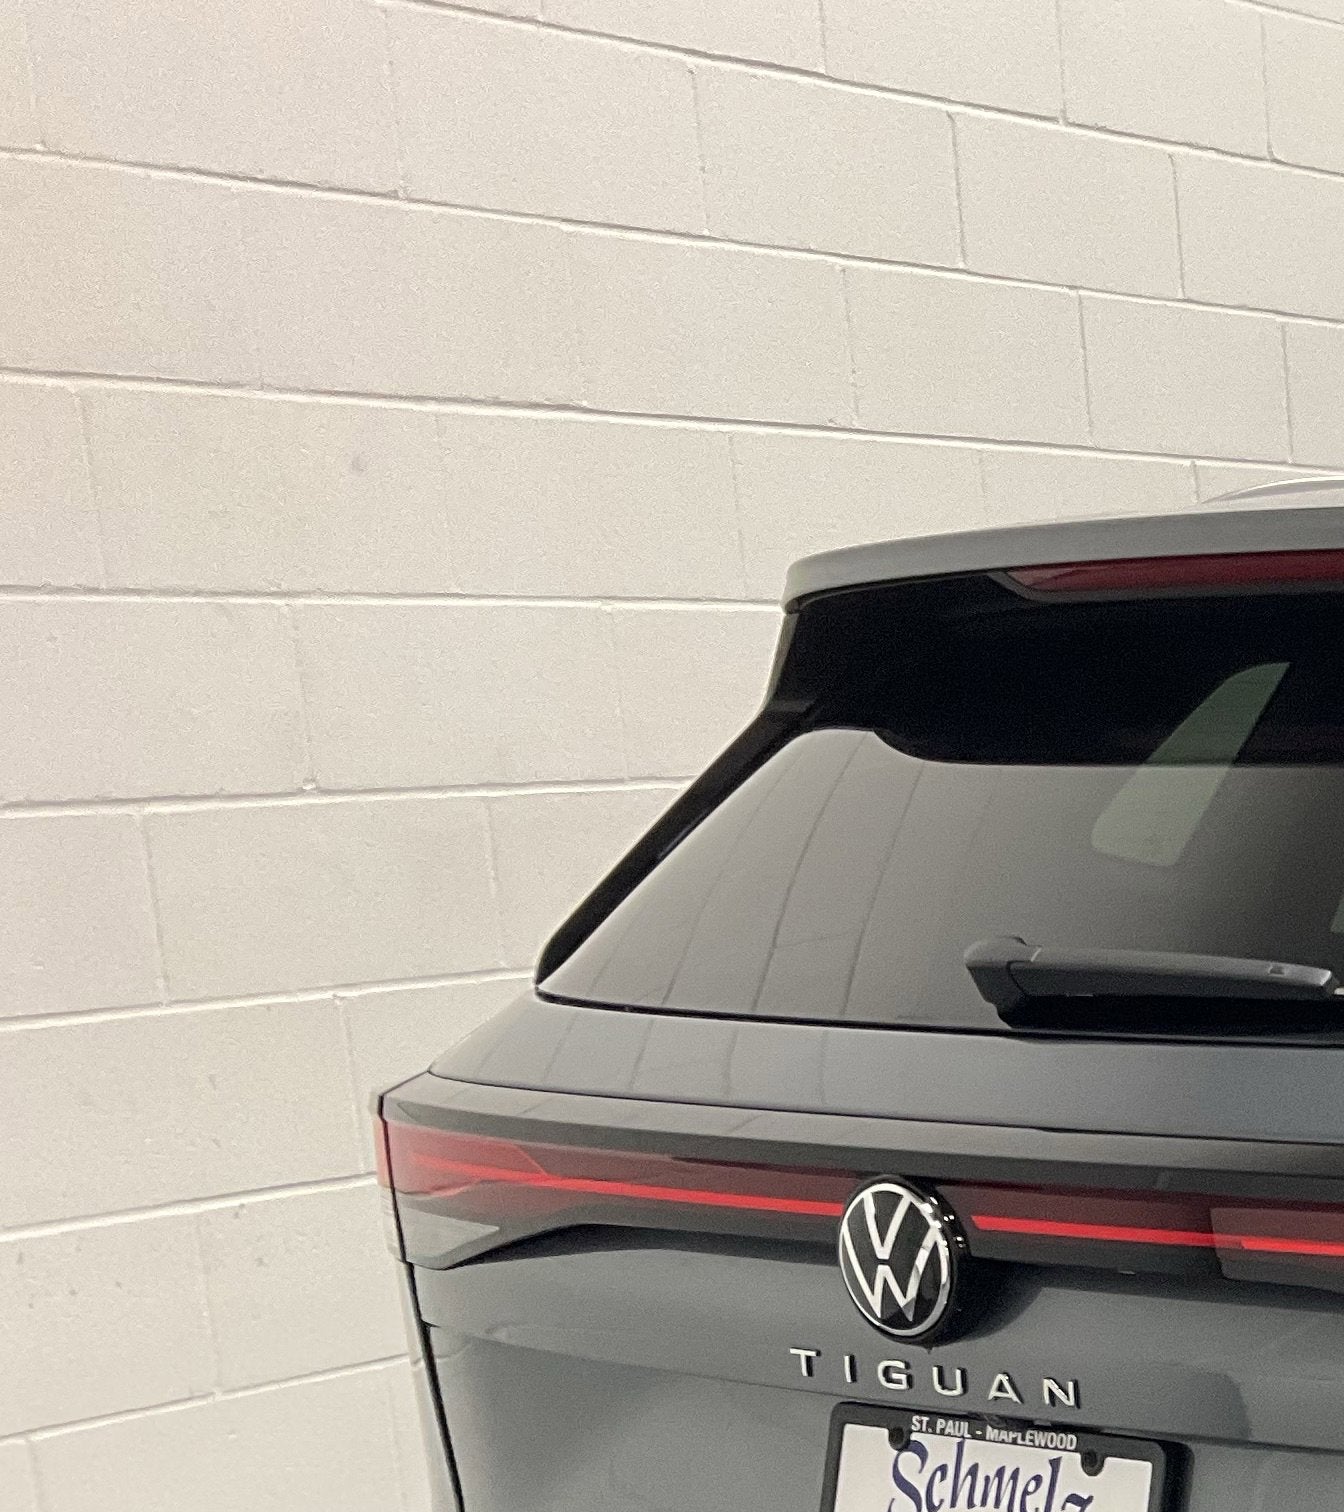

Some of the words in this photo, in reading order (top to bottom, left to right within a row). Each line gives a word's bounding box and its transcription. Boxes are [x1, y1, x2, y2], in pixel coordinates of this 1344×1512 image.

[789, 1347, 1079, 1408] TIGUAN
[911, 1415, 933, 1433] ST.
[936, 1418, 972, 1438] PAUL
[986, 1424, 1077, 1451] MAPLEWOOD
